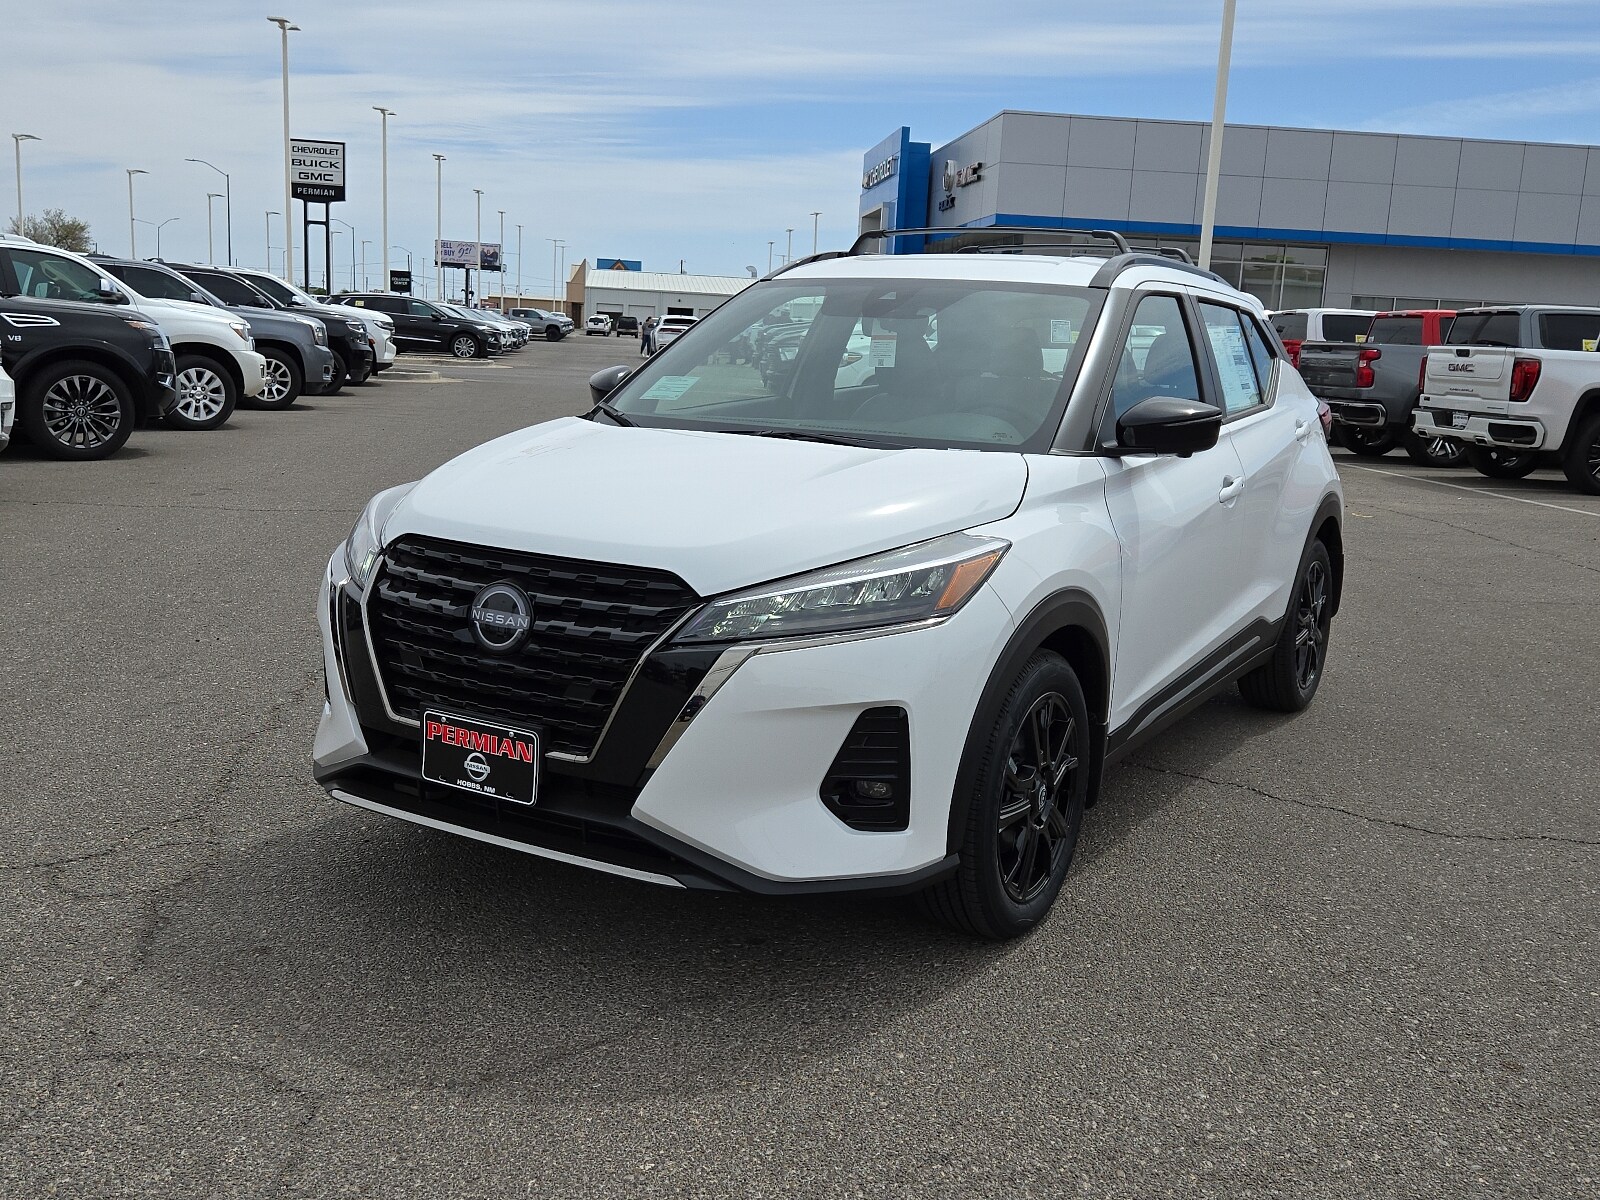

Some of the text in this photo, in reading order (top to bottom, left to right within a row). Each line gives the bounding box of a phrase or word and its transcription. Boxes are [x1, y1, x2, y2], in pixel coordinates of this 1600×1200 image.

[292, 145, 339, 156] CHEVROLET
[291, 158, 340, 169] BUICK
[298, 171, 334, 182] GMC
[297, 187, 335, 197] PERMIAN
[7, 334, 22, 342] V8
[1448, 363, 1475, 373] GMC
[472, 609, 529, 628] NISSAN
[426, 720, 534, 764] PERMIAN
[466, 761, 488, 773] NISSAN
[456, 779, 496, 794] HOBBS, NM
